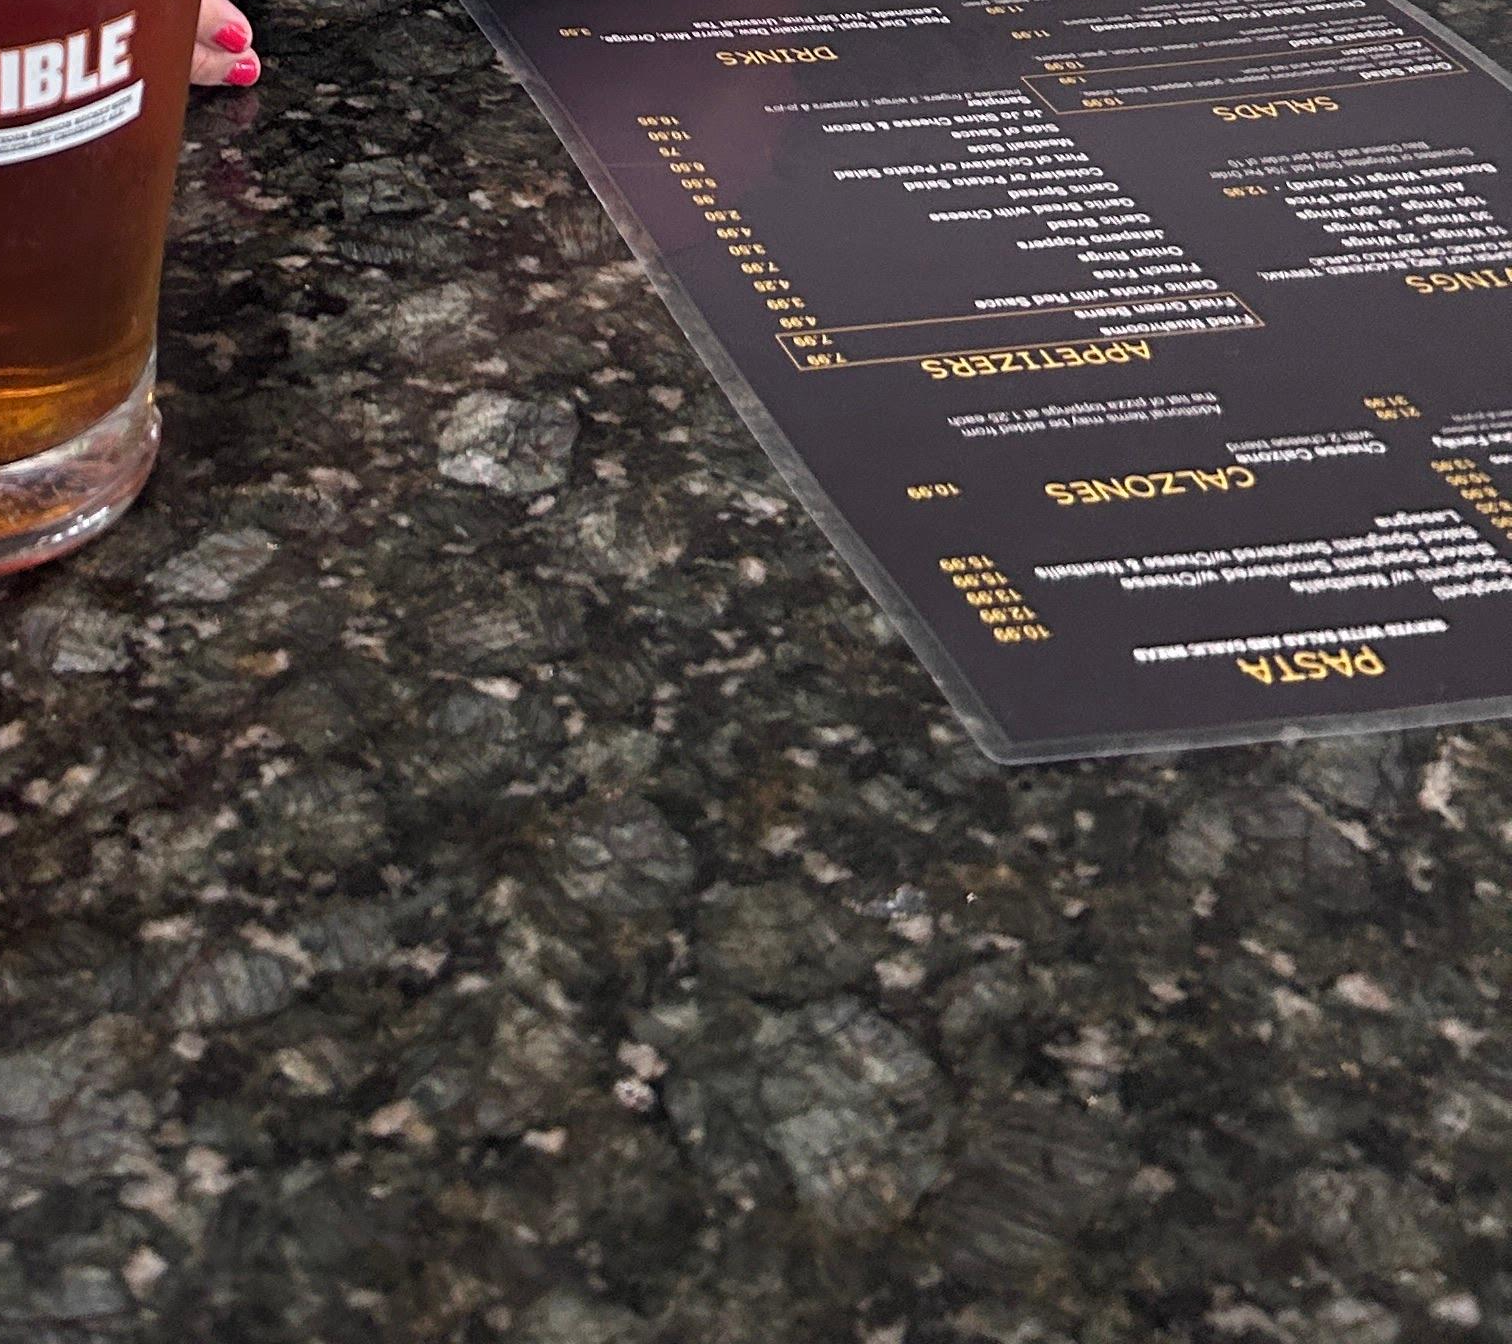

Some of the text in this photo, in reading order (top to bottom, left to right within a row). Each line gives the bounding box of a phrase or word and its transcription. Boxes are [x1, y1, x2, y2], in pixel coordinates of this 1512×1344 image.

[716, 46, 838, 66] DRINKS
[1213, 96, 1338, 121] SALADS
[822, 109, 1043, 133] Jo Jo Skins Cheese & Bacon
[950, 123, 1060, 139] Side of Sauce
[967, 138, 1075, 154] Meatball Side
[833, 152, 1090, 181] Pint of Coleslaw or Potato Salad
[903, 167, 1104, 192] Coleslaw or Potato Salad
[1007, 182, 1119, 200] Garlic Spread
[1284, 181, 1465, 206] All Wings Market Price
[929, 197, 1135, 222] Garlic Bread with Cheese
[1046, 213, 1151, 231] Garlic Bread
[1016, 229, 1164, 250] Jalapeno Poppers
[1077, 245, 1184, 263] Onion Rings
[1092, 262, 1202, 280] French Fries
[974, 279, 1218, 309] Garlic Knots with Red Sauce
[1074, 296, 1237, 319] Fried Green Beans
[1100, 314, 1257, 336] Fried Mushrooms
[918, 341, 1150, 379] APPETIZERS
[1235, 441, 1386, 464] Cheese Calzone
[1046, 462, 1254, 505] CALZONES
[1374, 509, 1461, 528] Lasagna
[1237, 646, 1384, 684] PASTA
